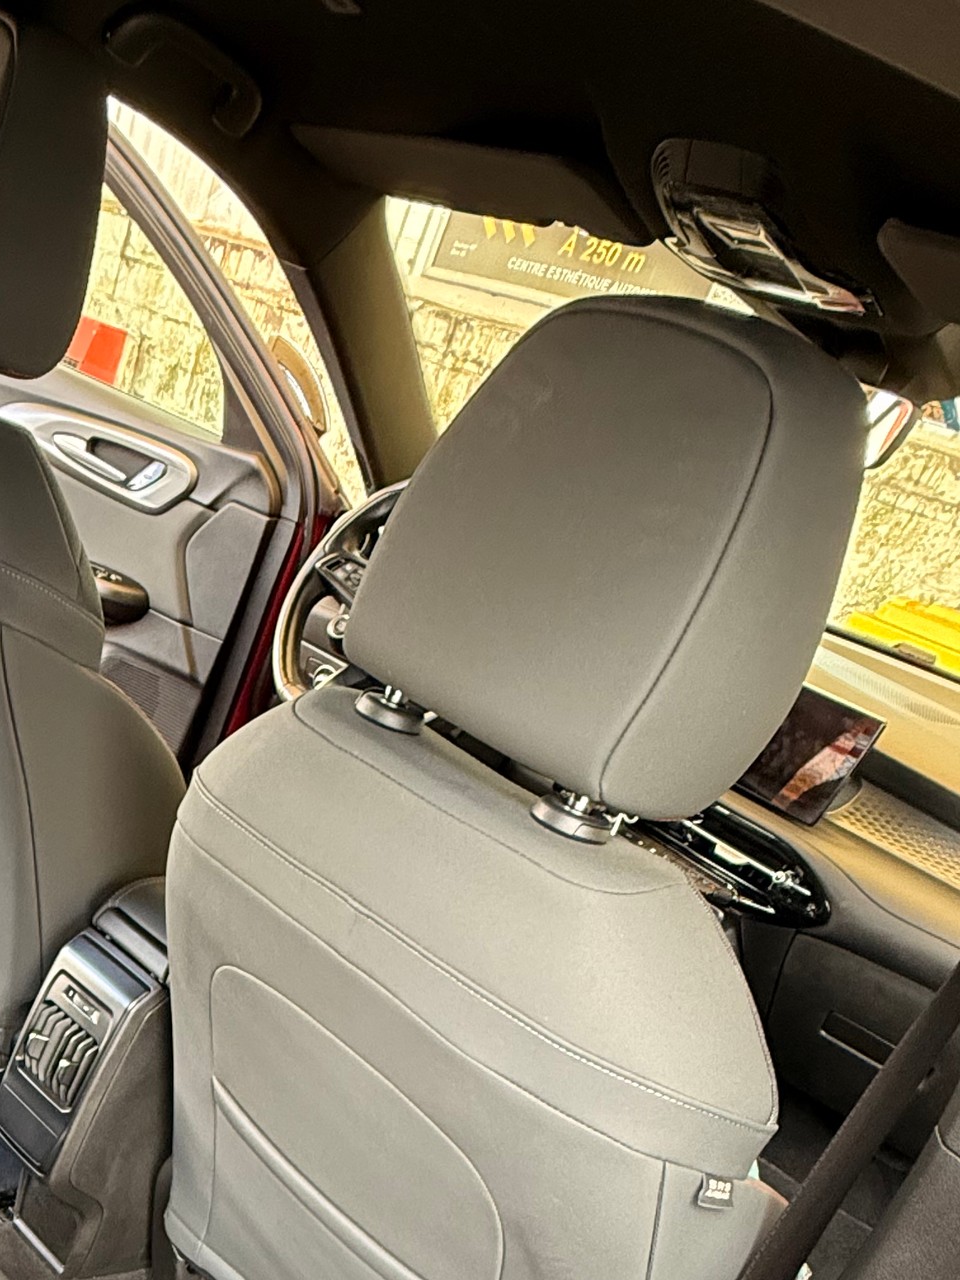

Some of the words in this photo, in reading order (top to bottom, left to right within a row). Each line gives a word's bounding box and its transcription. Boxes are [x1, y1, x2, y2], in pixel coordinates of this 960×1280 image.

[579, 236, 623, 267] 250
[621, 251, 646, 273] m
[507, 256, 548, 277] CENTRE
[545, 265, 612, 293] ESTHÉTIQUE
